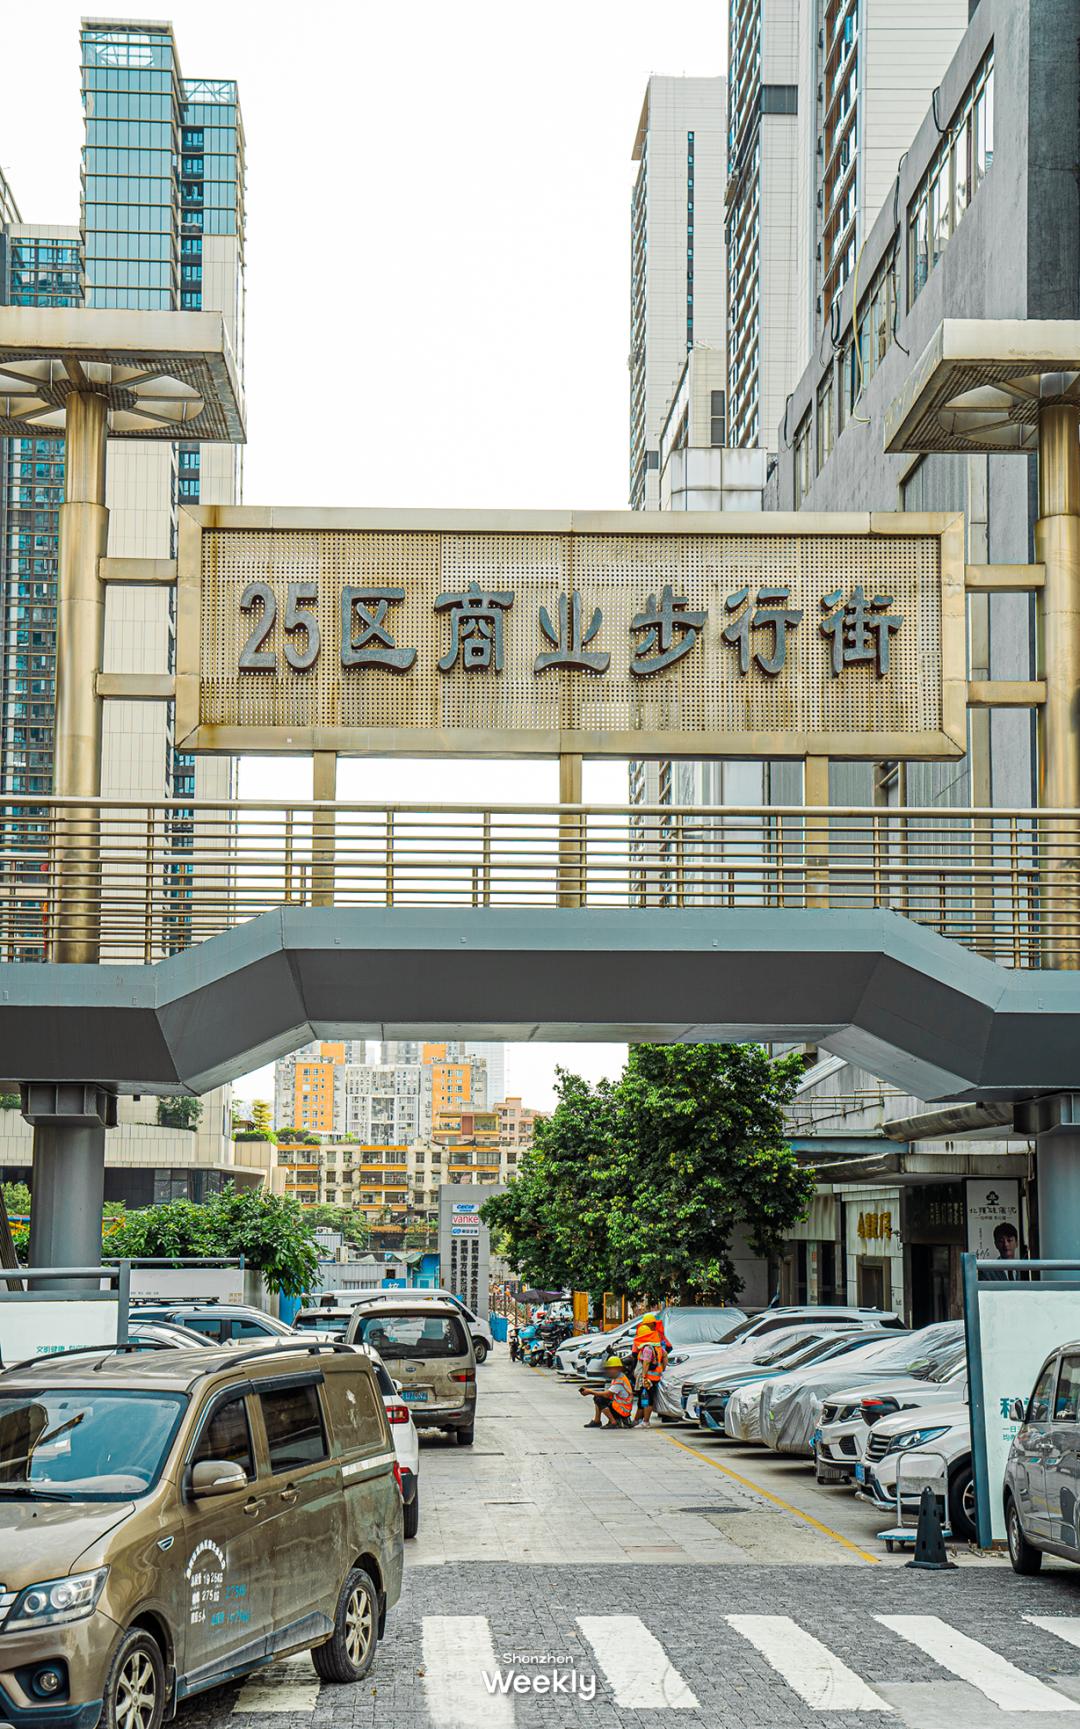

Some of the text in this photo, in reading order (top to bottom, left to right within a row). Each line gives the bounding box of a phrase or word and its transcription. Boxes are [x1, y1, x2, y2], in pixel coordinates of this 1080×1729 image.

[238, 580, 903, 678] 25区商业步行街
[453, 1215, 479, 1224] vanke
